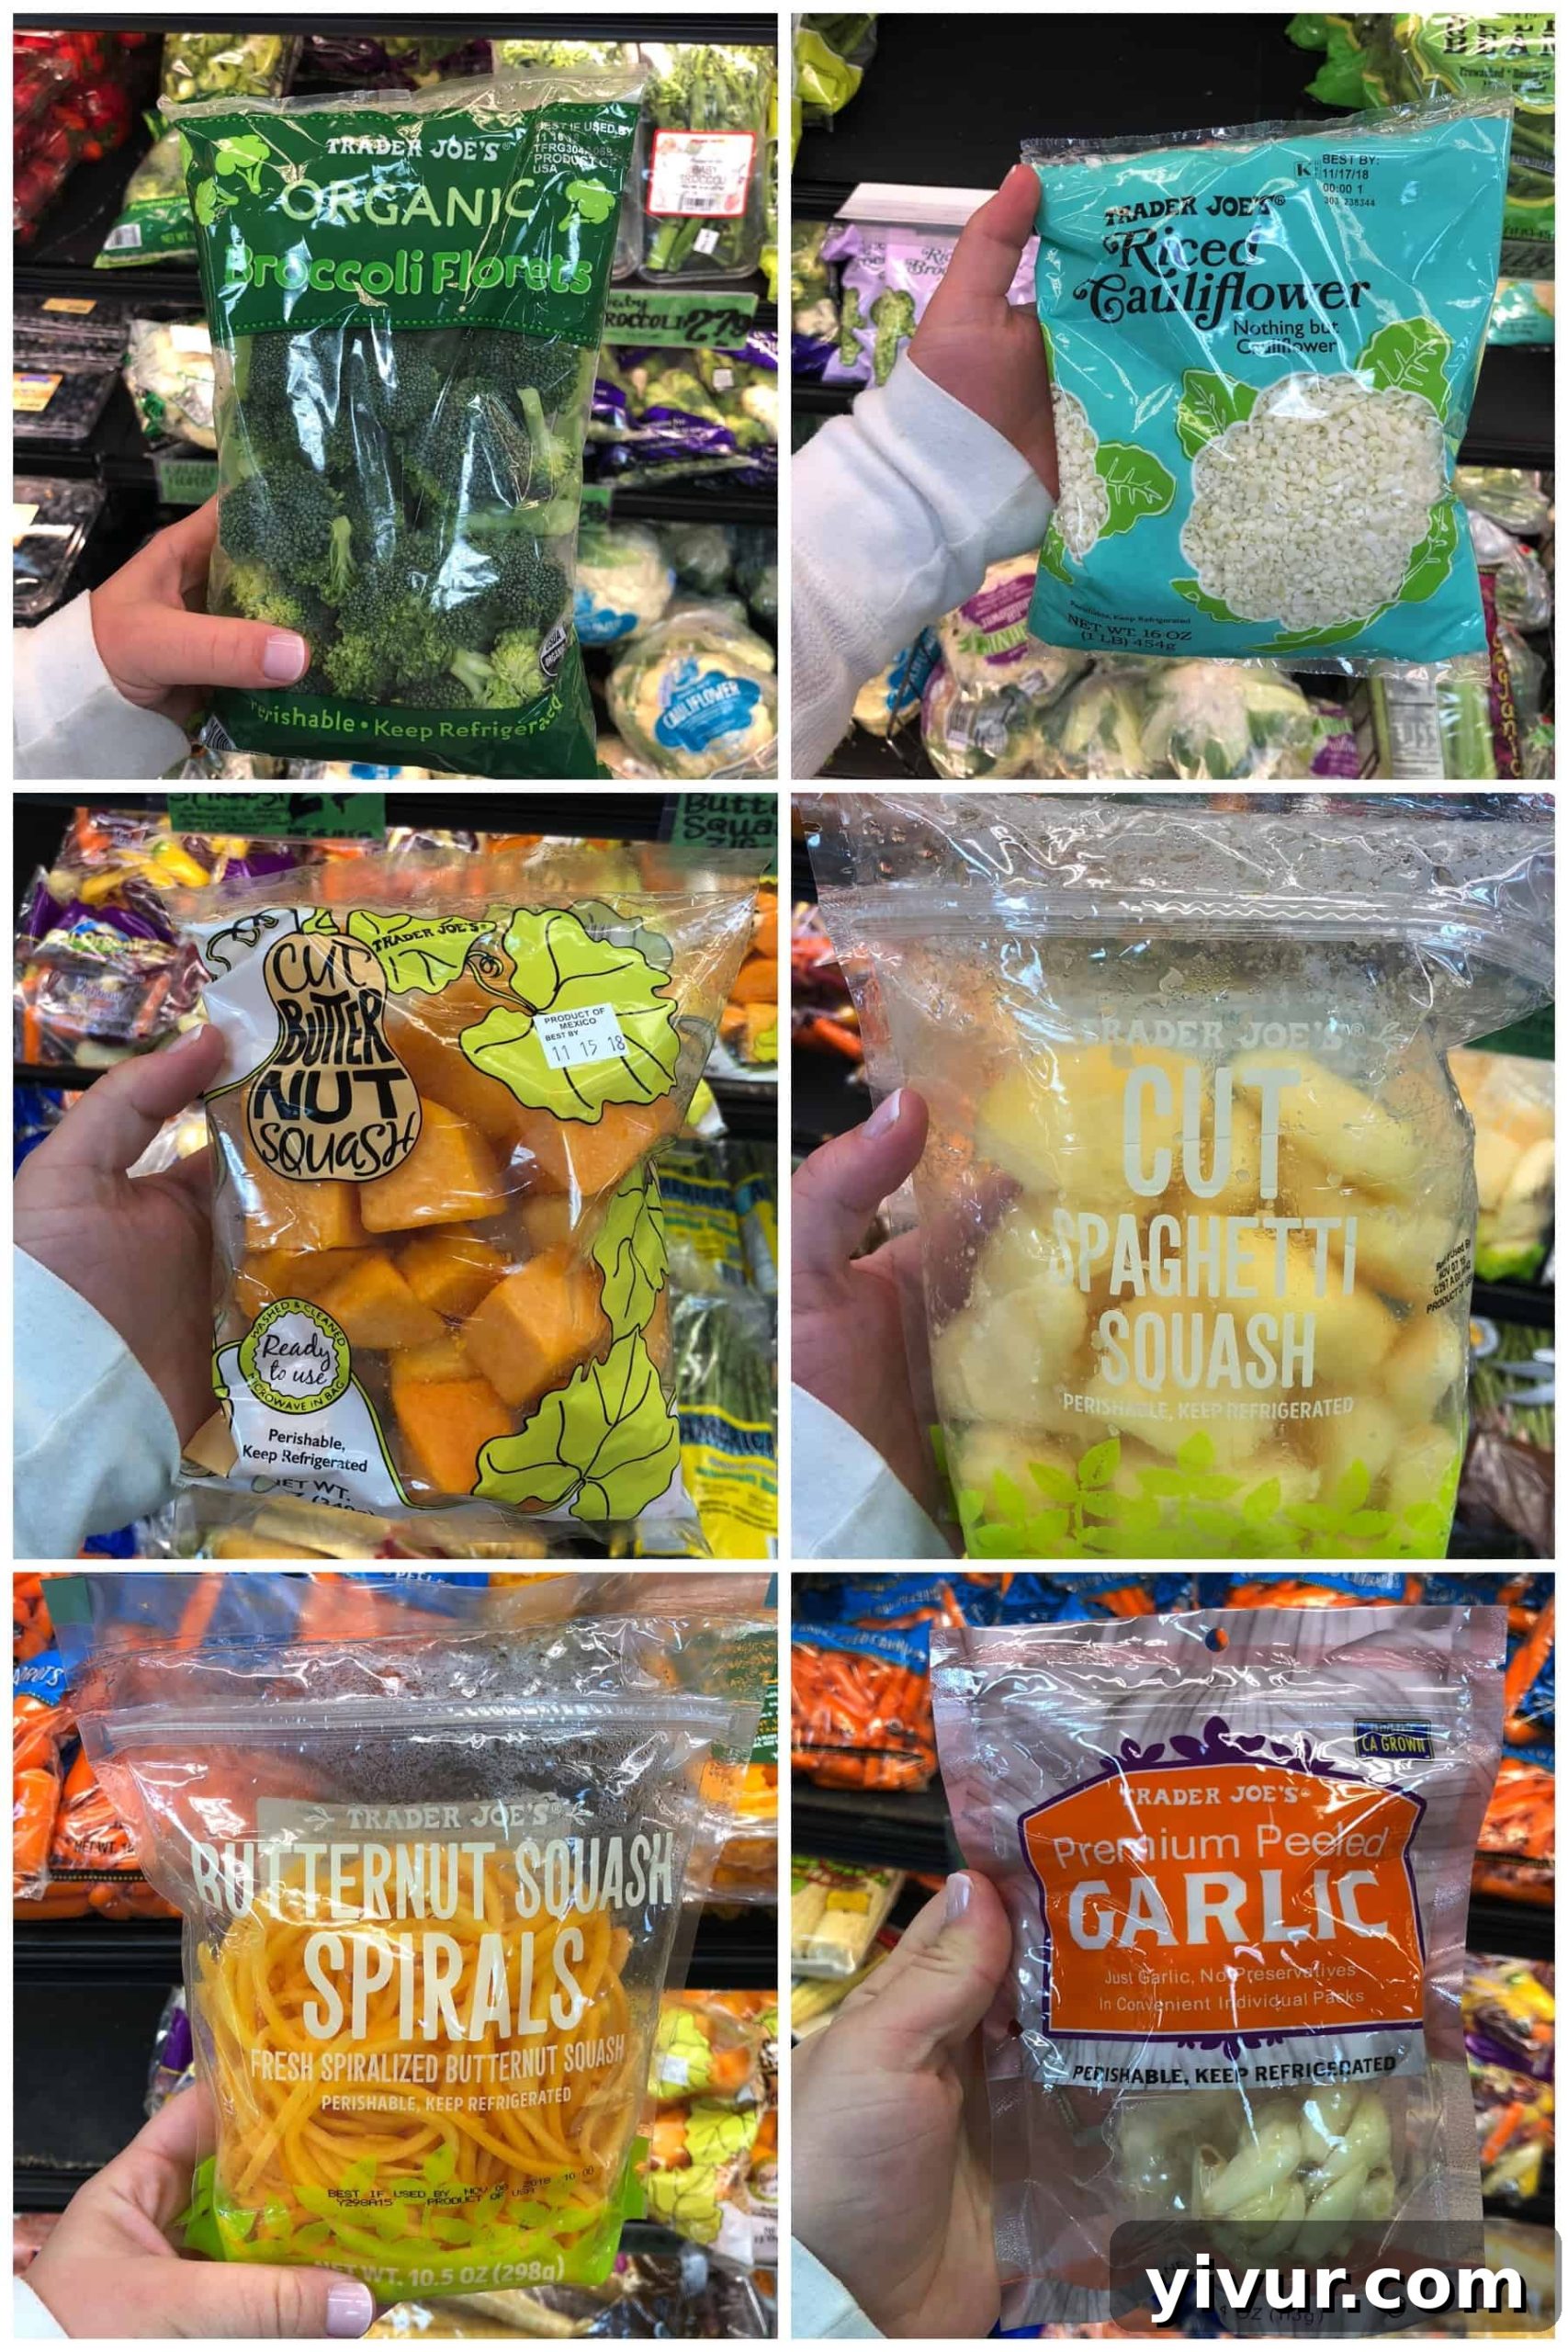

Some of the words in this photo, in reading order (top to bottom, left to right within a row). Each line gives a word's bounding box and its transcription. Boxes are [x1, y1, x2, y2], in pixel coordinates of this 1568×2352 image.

[584, 121, 615, 134] USED
[325, 136, 423, 158] TRADER
[1323, 153, 1355, 165] BEST
[1359, 154, 1379, 165] BY:
[533, 165, 558, 174] USA
[1323, 169, 1369, 181] 11/17/18
[281, 179, 536, 228] ORGANIC
[1323, 184, 1352, 195] 00:00
[1104, 196, 1195, 227] TRADER
[1103, 226, 1259, 277] Riced
[223, 245, 424, 296] Broccoli
[432, 248, 592, 295] Florets
[1073, 266, 1371, 333] Cauliflower
[1234, 319, 1304, 338] Nothing
[1310, 320, 1338, 337] but
[1236, 338, 1337, 356] Cauliflower
[1066, 612, 1101, 632] NET
[1144, 628, 1161, 640] 16
[1167, 630, 1192, 641] OZ
[1080, 631, 1094, 642] (1
[1100, 633, 1128, 649] LB)
[1134, 638, 1177, 652] 454g
[661, 679, 740, 729] CAULIFLOWER
[375, 718, 433, 742] Keep
[372, 928, 434, 953] TRADER
[273, 939, 371, 993] CUT
[273, 989, 395, 1066] BUTTER
[544, 1012, 590, 1024] PRODUCT
[592, 1007, 605, 1016] OF
[559, 1017, 597, 1030] MEXICO
[545, 1033, 566, 1042] BEST
[569, 1029, 579, 1037] BY
[1081, 1017, 1224, 1049] TRADER
[552, 1045, 570, 1062] 11
[580, 1039, 598, 1057] 15
[608, 1035, 626, 1053] 18
[254, 1069, 407, 1124] NUT
[1123, 1065, 1302, 1200] CUT
[1049, 1207, 1358, 1298] SPAGHETTI
[251, 1301, 288, 1340] WASHED
[304, 1304, 345, 1347] CLEANED
[262, 1333, 331, 1372] Ready
[1099, 1308, 1316, 1392] SQUASH
[270, 1359, 287, 1381] to
[292, 1370, 328, 1385] use
[248, 1373, 307, 1411] MICROWAVE
[310, 1398, 323, 1408] IN
[325, 1380, 345, 1402] BAG
[1063, 1393, 1173, 1421] PERISHABLE,
[1179, 1401, 1222, 1419] KEEP
[1227, 1396, 1354, 1420] REFRIGERATED
[268, 1429, 345, 1453] Perishable,
[243, 1444, 277, 1463] Keep
[282, 1450, 368, 1473] Refrigerated
[313, 1479, 351, 1501] WT.
[1361, 1736, 1378, 1751] CA
[1381, 1736, 1426, 1753] GROWN
[1119, 1787, 1220, 1806] TRADER
[346, 1804, 462, 1832] TRADER
[1055, 1827, 1240, 1869] Premium
[1257, 1824, 1390, 1858] Peeled
[191, 1841, 495, 1921] BUTTERNUT
[515, 1832, 674, 1921] SQUASH
[1068, 1869, 1388, 1951] GARLIC
[303, 1928, 584, 2041] SPIRALS
[1104, 1970, 1134, 1985] Just
[1200, 1969, 1227, 1984] No
[1236, 1963, 1357, 1984] Preservatives
[1100, 1998, 1111, 2010] In
[1116, 1996, 1211, 2013] Convenient
[1219, 1990, 1308, 2011] Individual
[1314, 1988, 1365, 2006] Packs
[251, 2049, 314, 2082] FRESH
[321, 2052, 437, 2084] SPIRALIZED
[446, 2045, 558, 2084] BUTTERNUT
[564, 2034, 626, 2074] SQUASH
[1072, 2064, 1189, 2087] PERISHABLE,
[1195, 2067, 1248, 2085] KEEP
[1256, 2054, 1396, 2083] REFRIGERATED
[321, 2095, 421, 2113] PERISHABLE,
[426, 2097, 463, 2112] KEEP
[468, 2086, 571, 2112] REFRIGERATED
[328, 2188, 363, 2199] BEST
[369, 2188, 385, 2199] IF
[393, 2188, 426, 2199] USED
[433, 2188, 450, 2199] BY
[523, 2177, 551, 2189] 2018
[426, 2195, 481, 2207] PRODUCT
[489, 2192, 504, 2201] OF
[512, 2186, 536, 2198] USA
[363, 2267, 404, 2288] WT.
[409, 2268, 454, 2287] 10.5
[460, 2266, 488, 2284] OZ
[492, 2255, 565, 2286] (298g)
